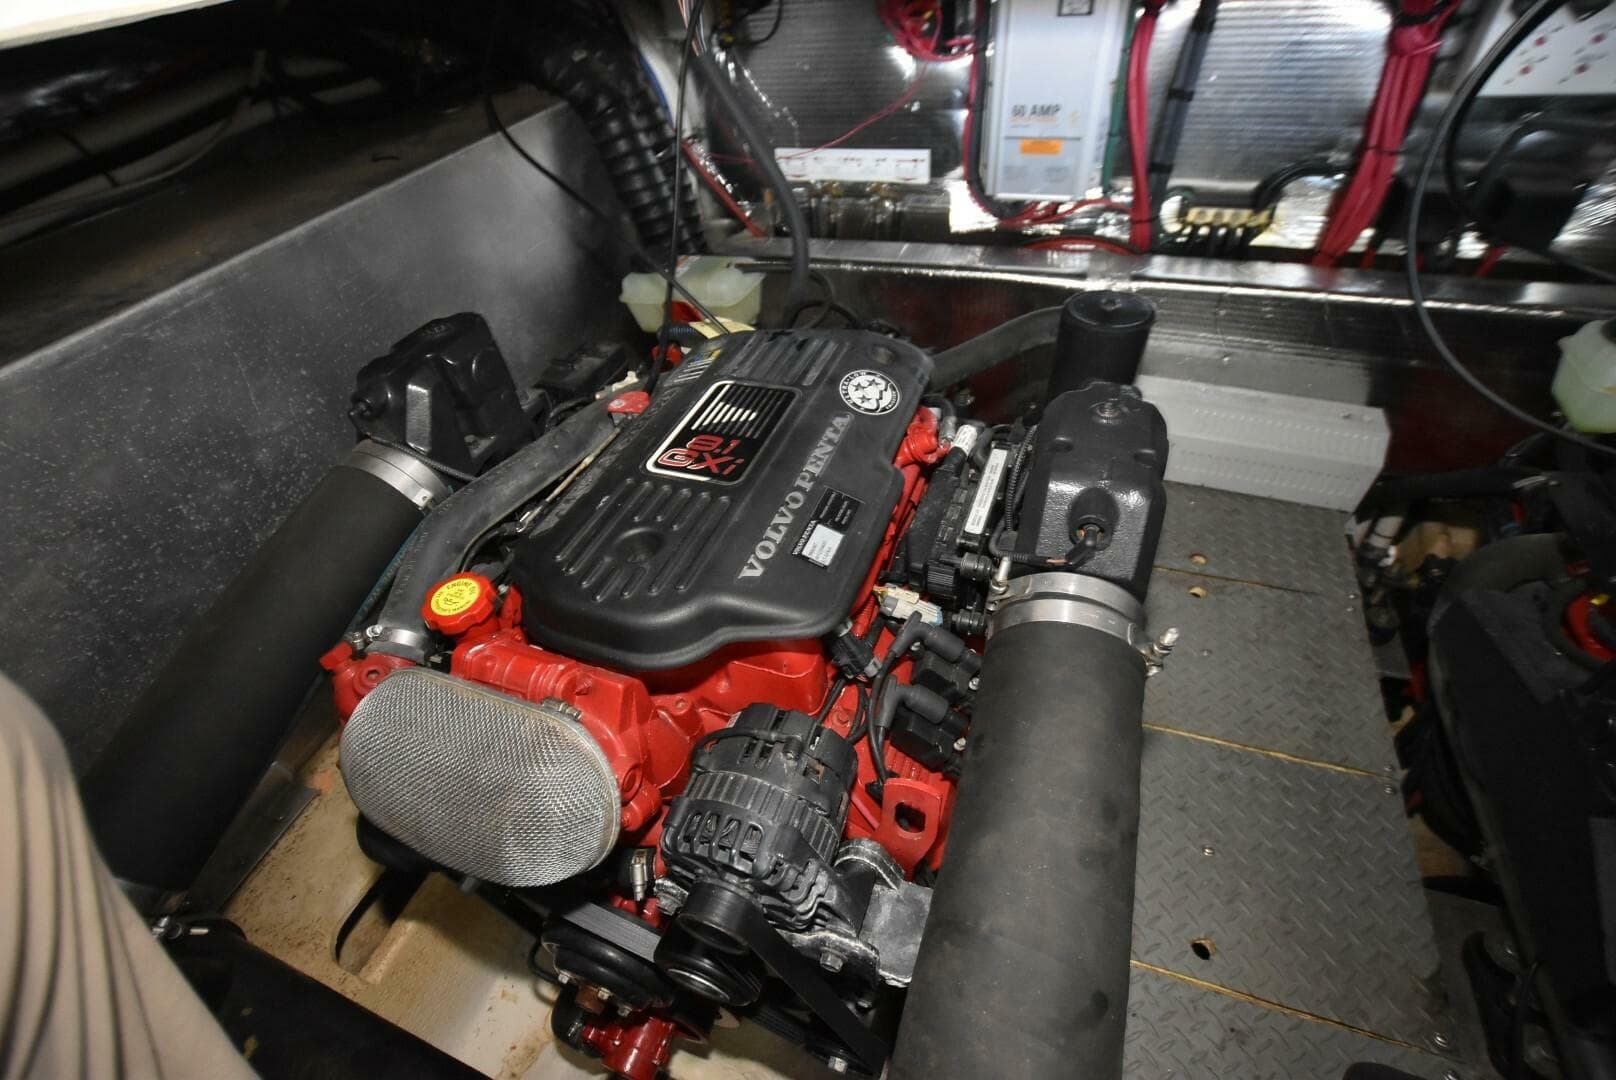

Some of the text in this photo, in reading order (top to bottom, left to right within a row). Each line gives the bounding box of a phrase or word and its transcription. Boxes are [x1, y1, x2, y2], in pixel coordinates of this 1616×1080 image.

[1030, 102, 1062, 116] AMP
[686, 434, 741, 455] 8.1
[737, 412, 851, 579] VOLVO PENTA
